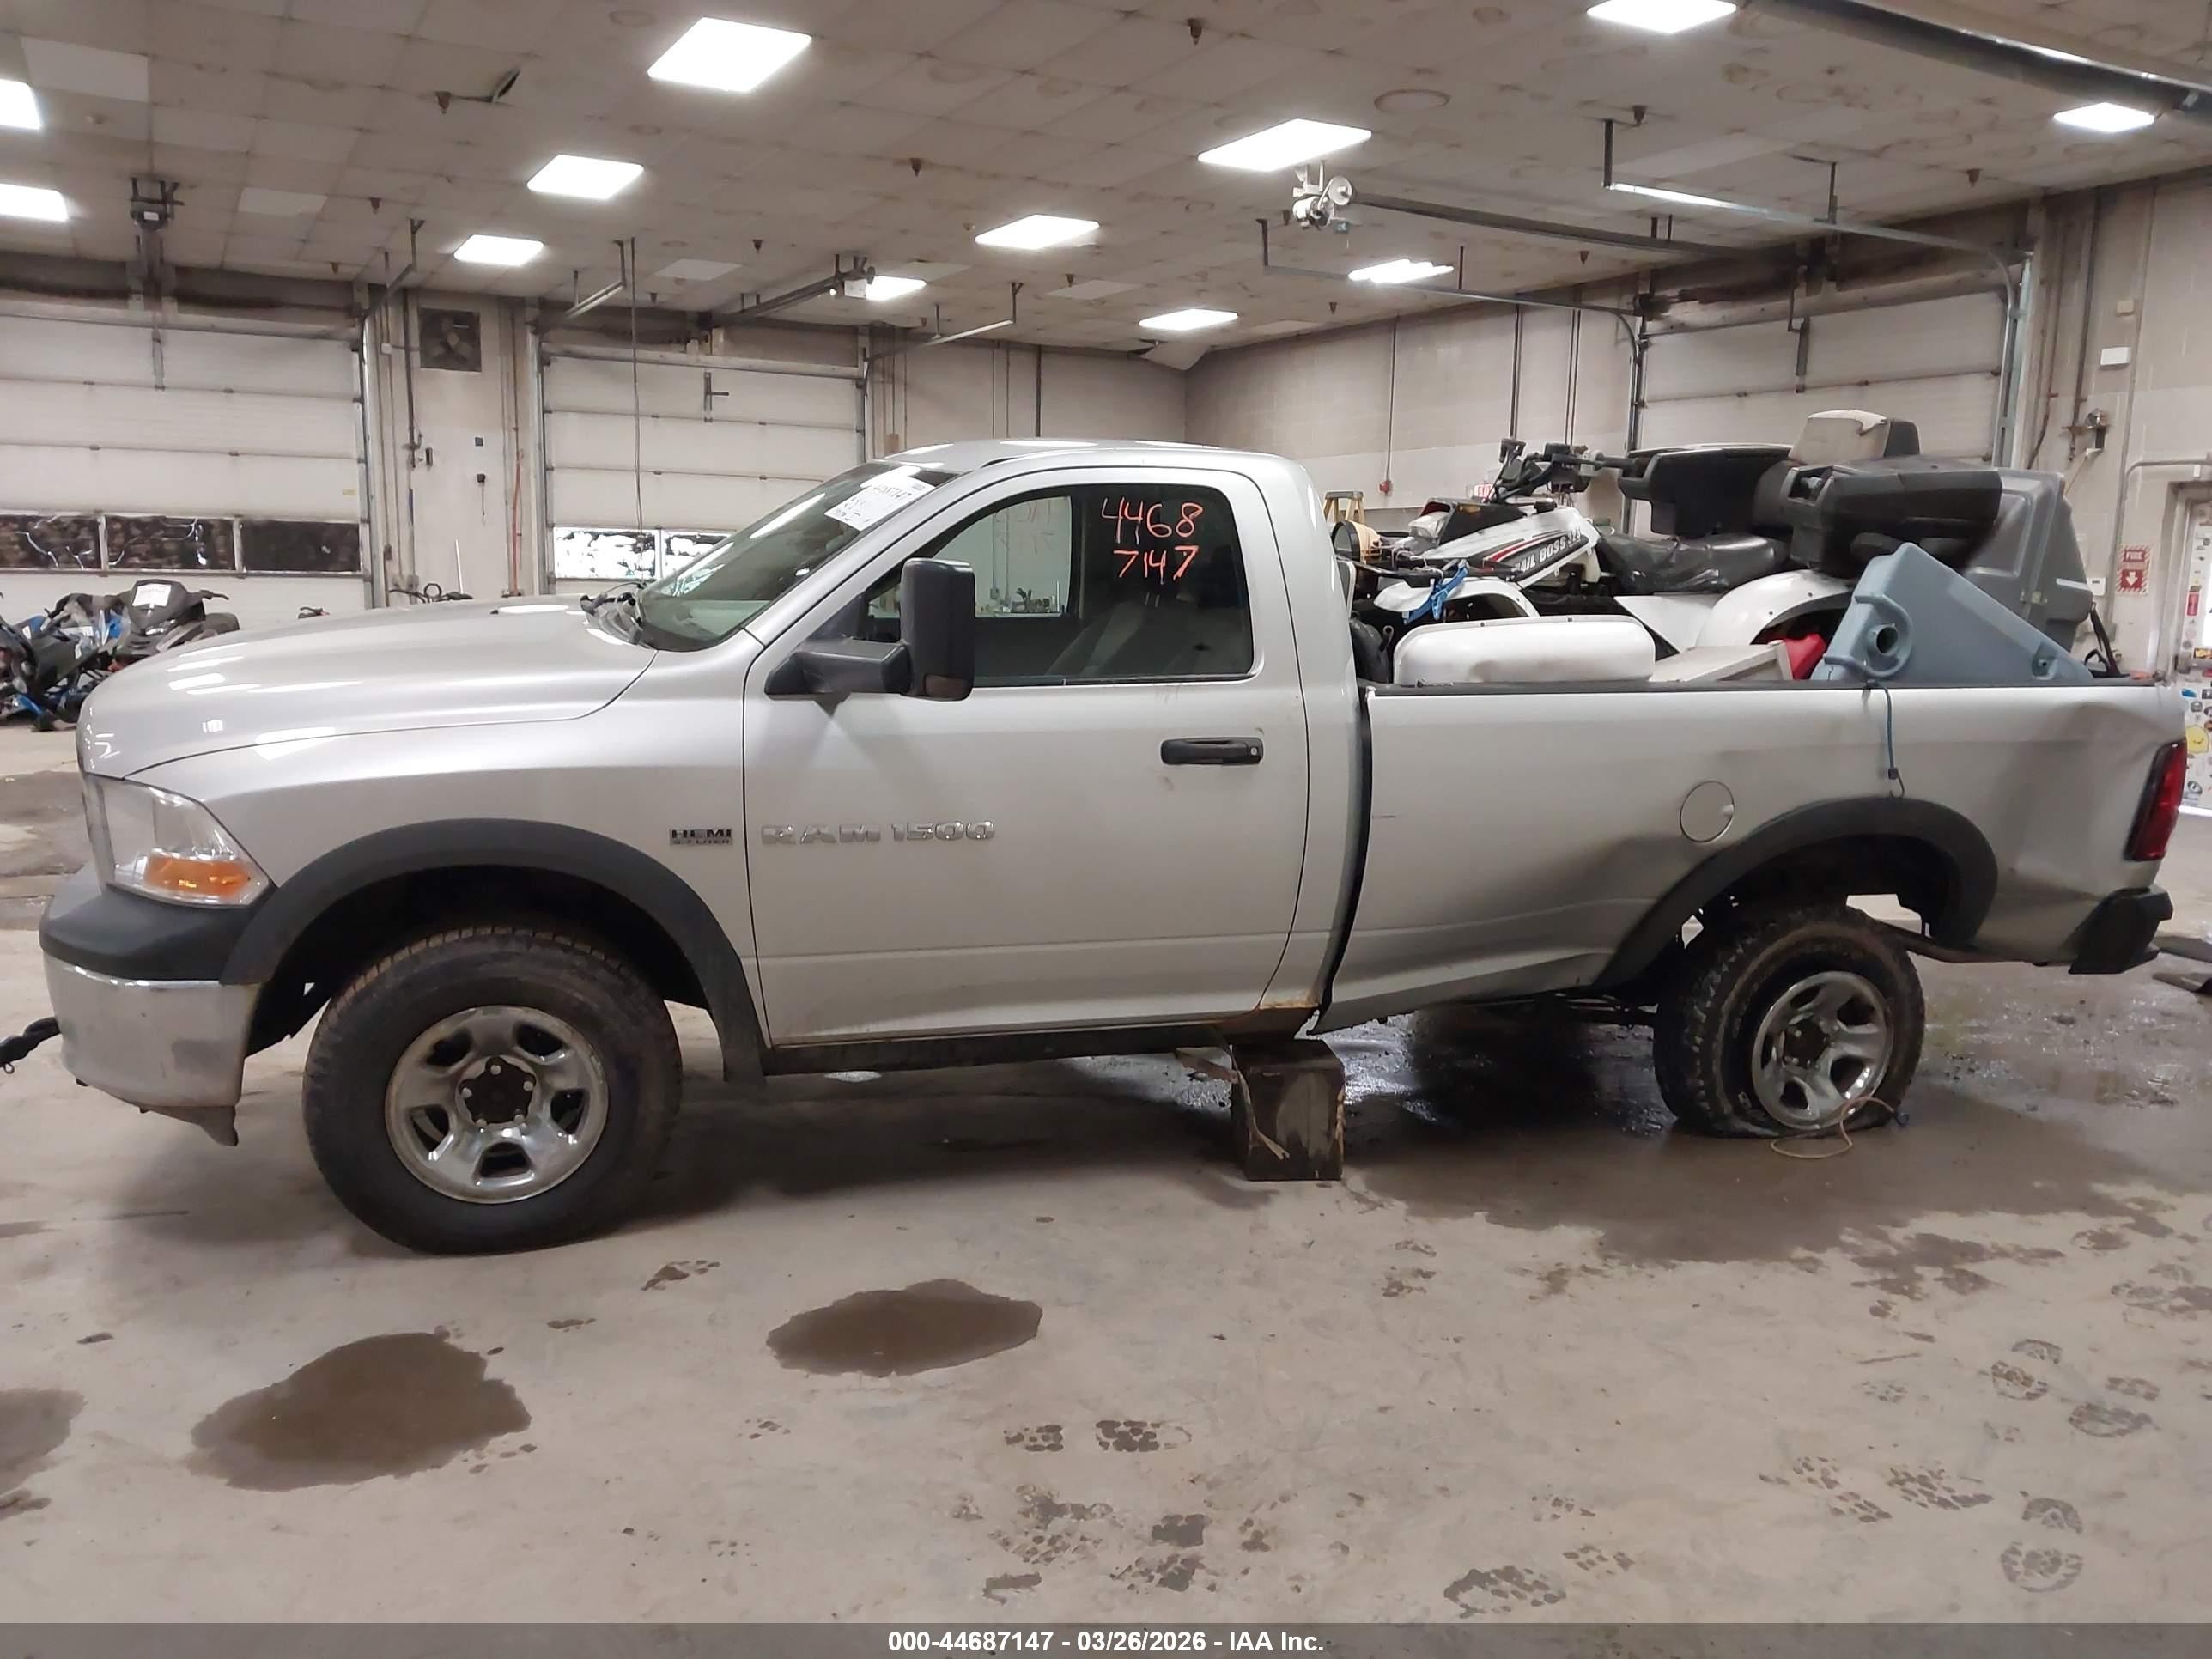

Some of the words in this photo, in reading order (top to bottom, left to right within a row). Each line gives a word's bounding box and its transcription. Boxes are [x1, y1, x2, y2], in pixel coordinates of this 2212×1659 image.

[1101, 496, 1204, 544] 4468
[1539, 536, 1566, 562] BOSS
[1113, 545, 1200, 585] 7147
[672, 829, 732, 839] HEMI
[762, 824, 881, 845] RAM
[891, 820, 996, 842] 1500
